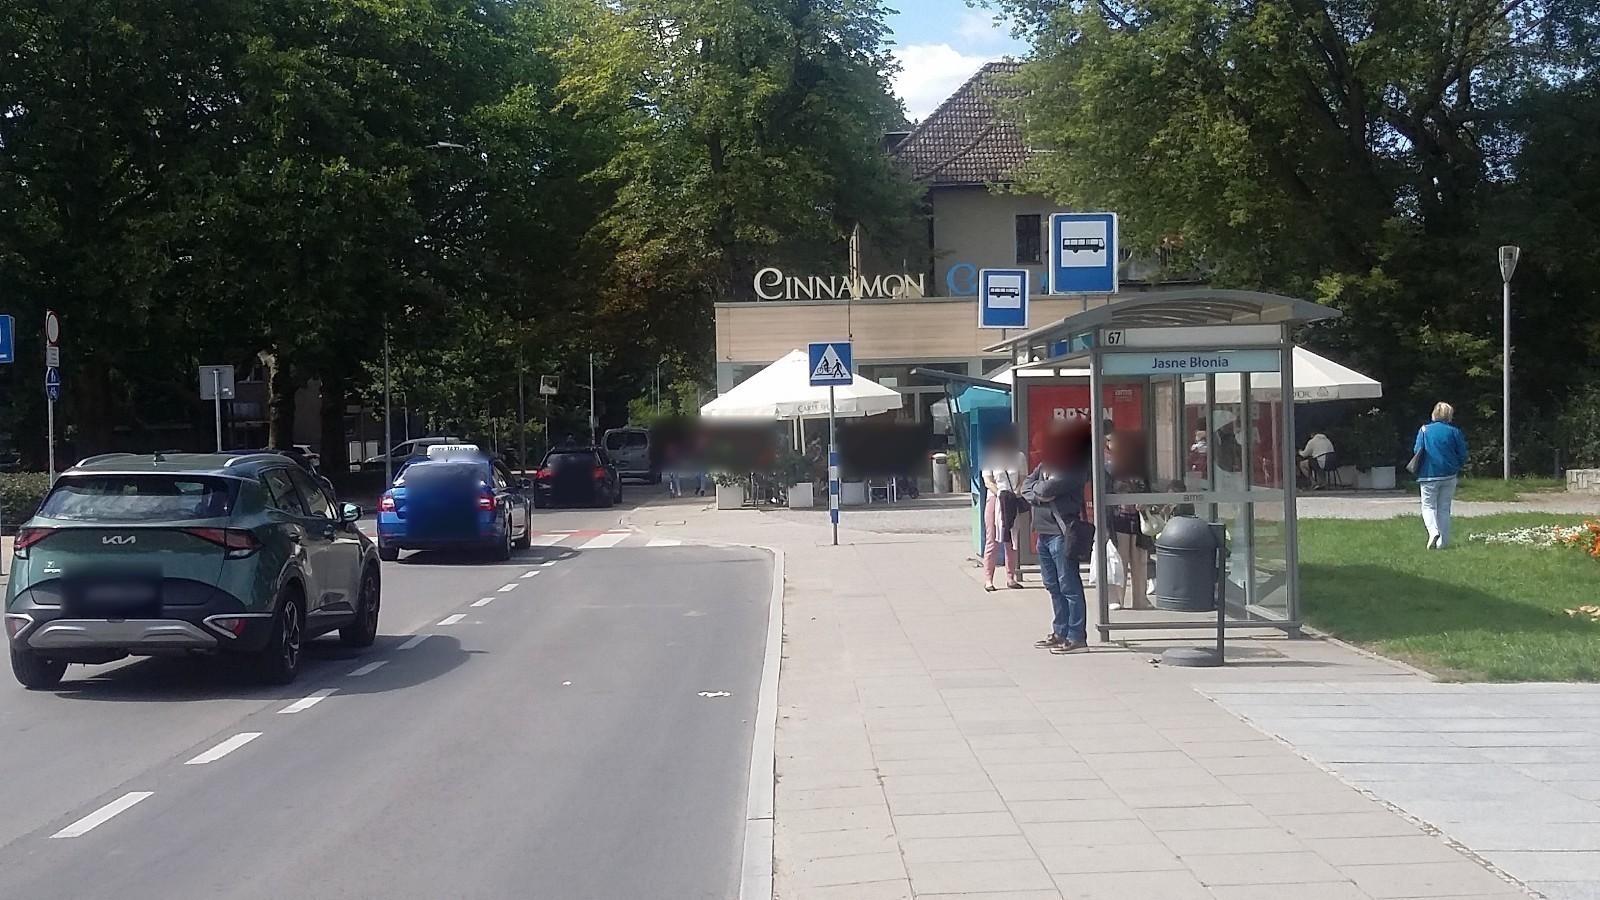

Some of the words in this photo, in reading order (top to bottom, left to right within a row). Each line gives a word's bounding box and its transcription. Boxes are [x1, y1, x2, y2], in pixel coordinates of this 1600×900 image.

[753, 267, 925, 301] CINNAMON
[1107, 331, 1121, 345] 67
[1151, 357, 1186, 370] Jasne
[1189, 356, 1229, 369] Błonia
